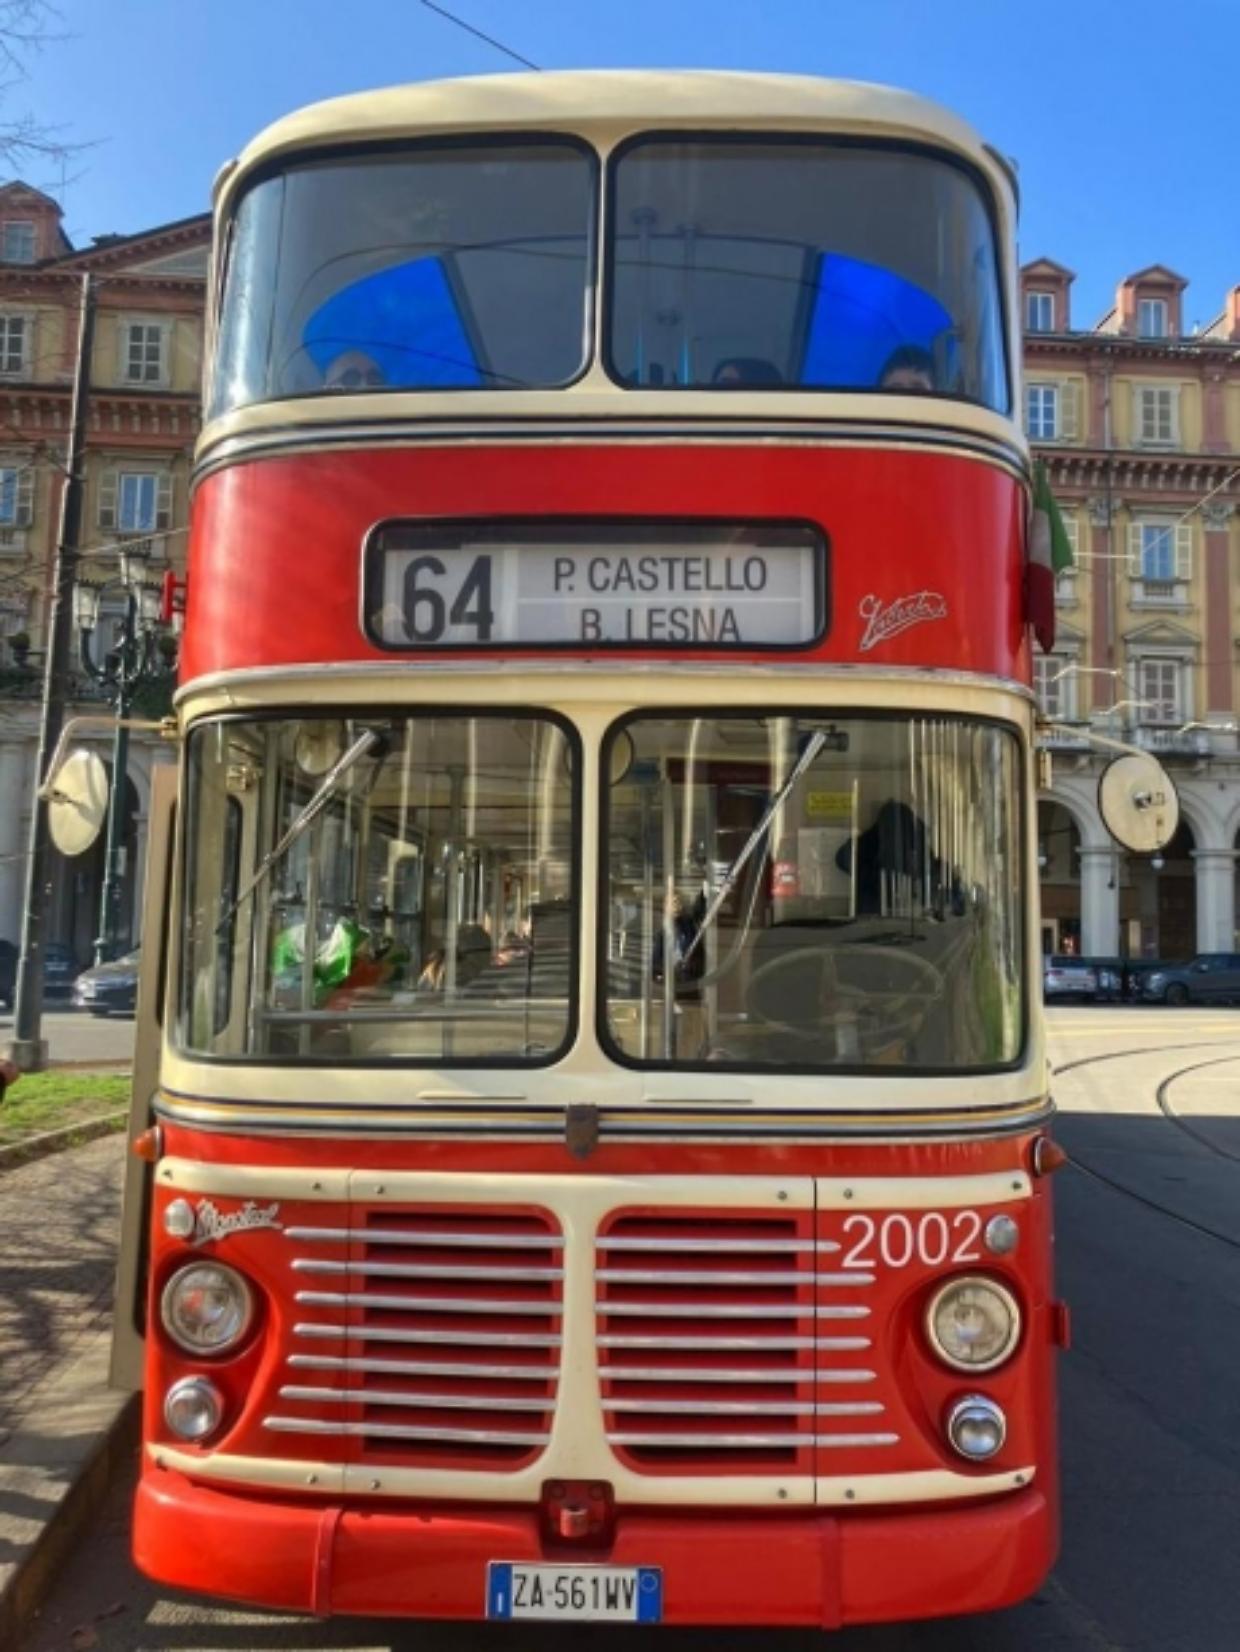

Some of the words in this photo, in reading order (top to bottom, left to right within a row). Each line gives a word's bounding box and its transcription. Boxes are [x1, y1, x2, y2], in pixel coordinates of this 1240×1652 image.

[554, 557, 576, 591] P.
[587, 557, 767, 591] CASTELLO
[402, 555, 494, 641] 64
[581, 608, 612, 641] B.
[626, 608, 742, 641] LESNA
[842, 1210, 982, 1268] 2002
